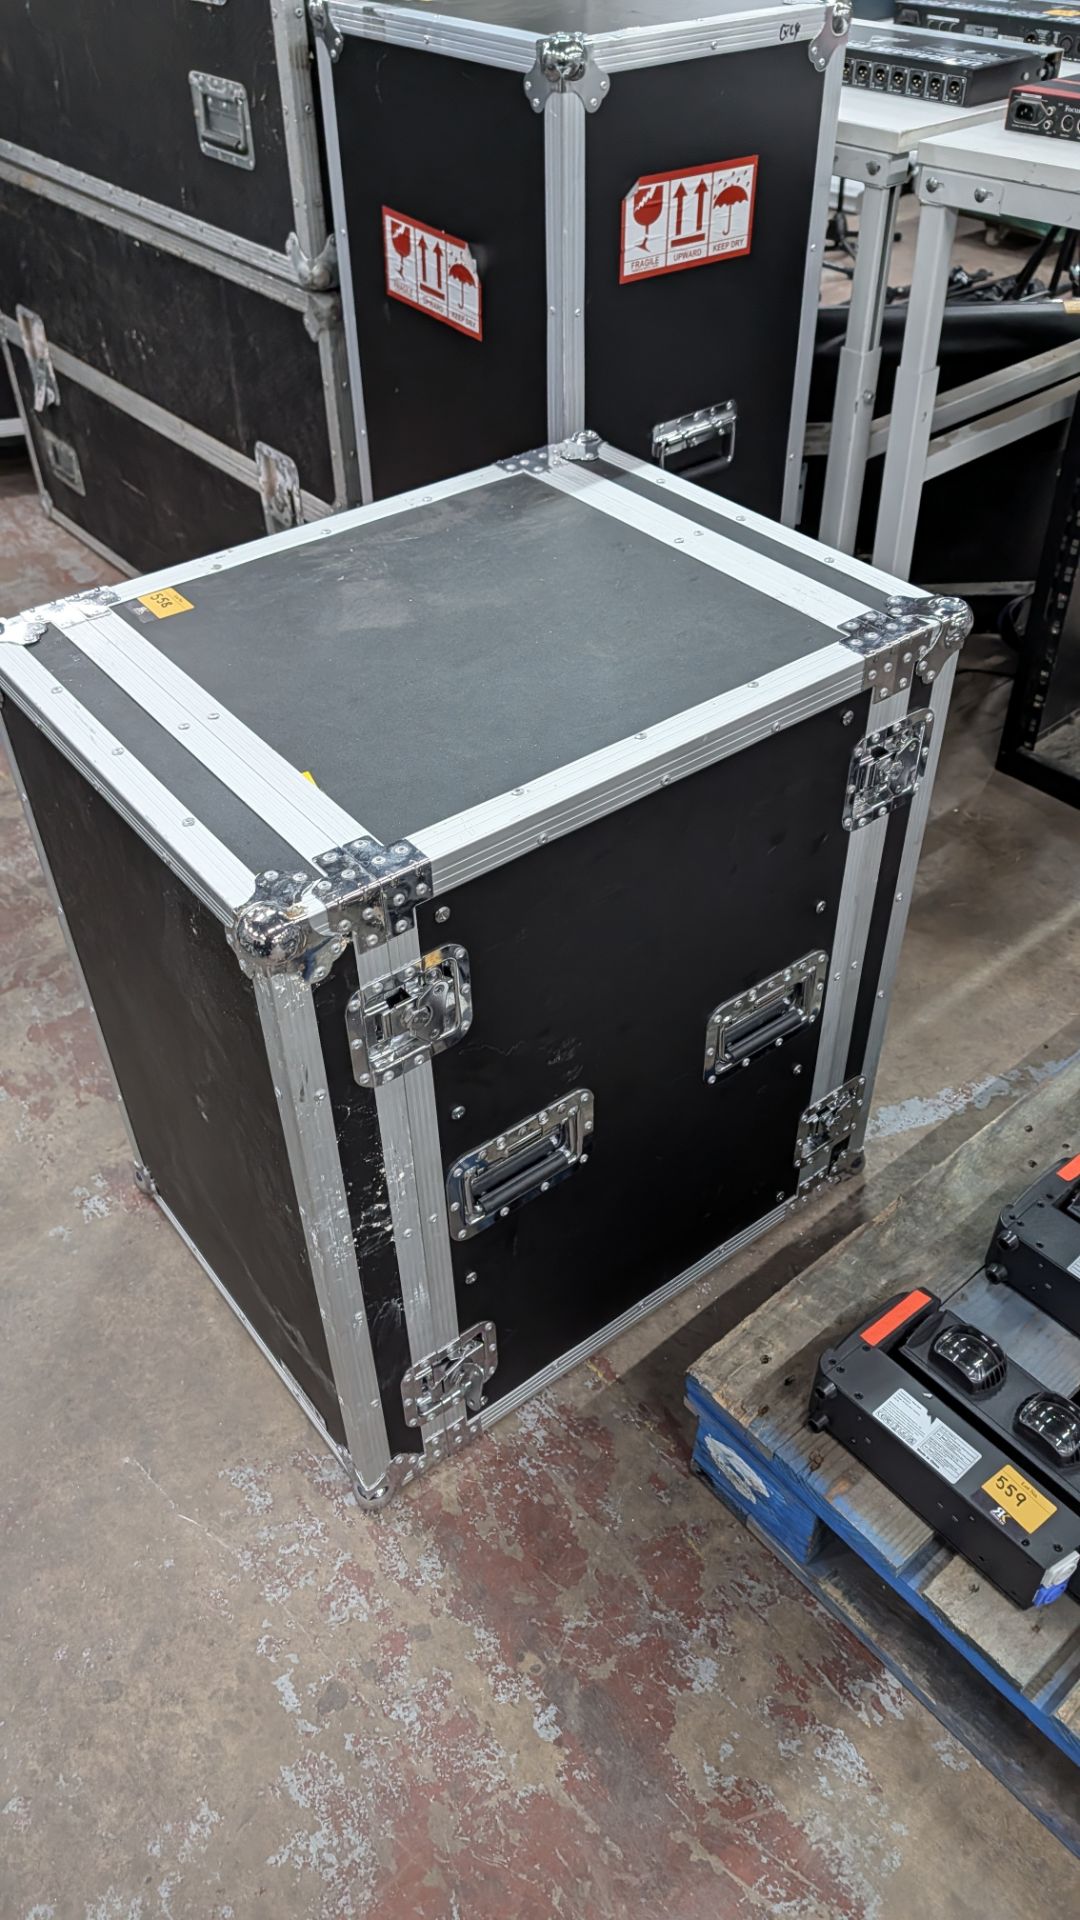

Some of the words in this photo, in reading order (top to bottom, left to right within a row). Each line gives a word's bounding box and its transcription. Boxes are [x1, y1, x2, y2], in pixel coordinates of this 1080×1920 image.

[713, 242, 730, 252] KEEP
[730, 239, 744, 248] DRY
[673, 248, 702, 261] UPWARD
[631, 256, 659, 270] FRAGILE
[150, 593, 173, 608] 558
[995, 1475, 1027, 1507] 559
